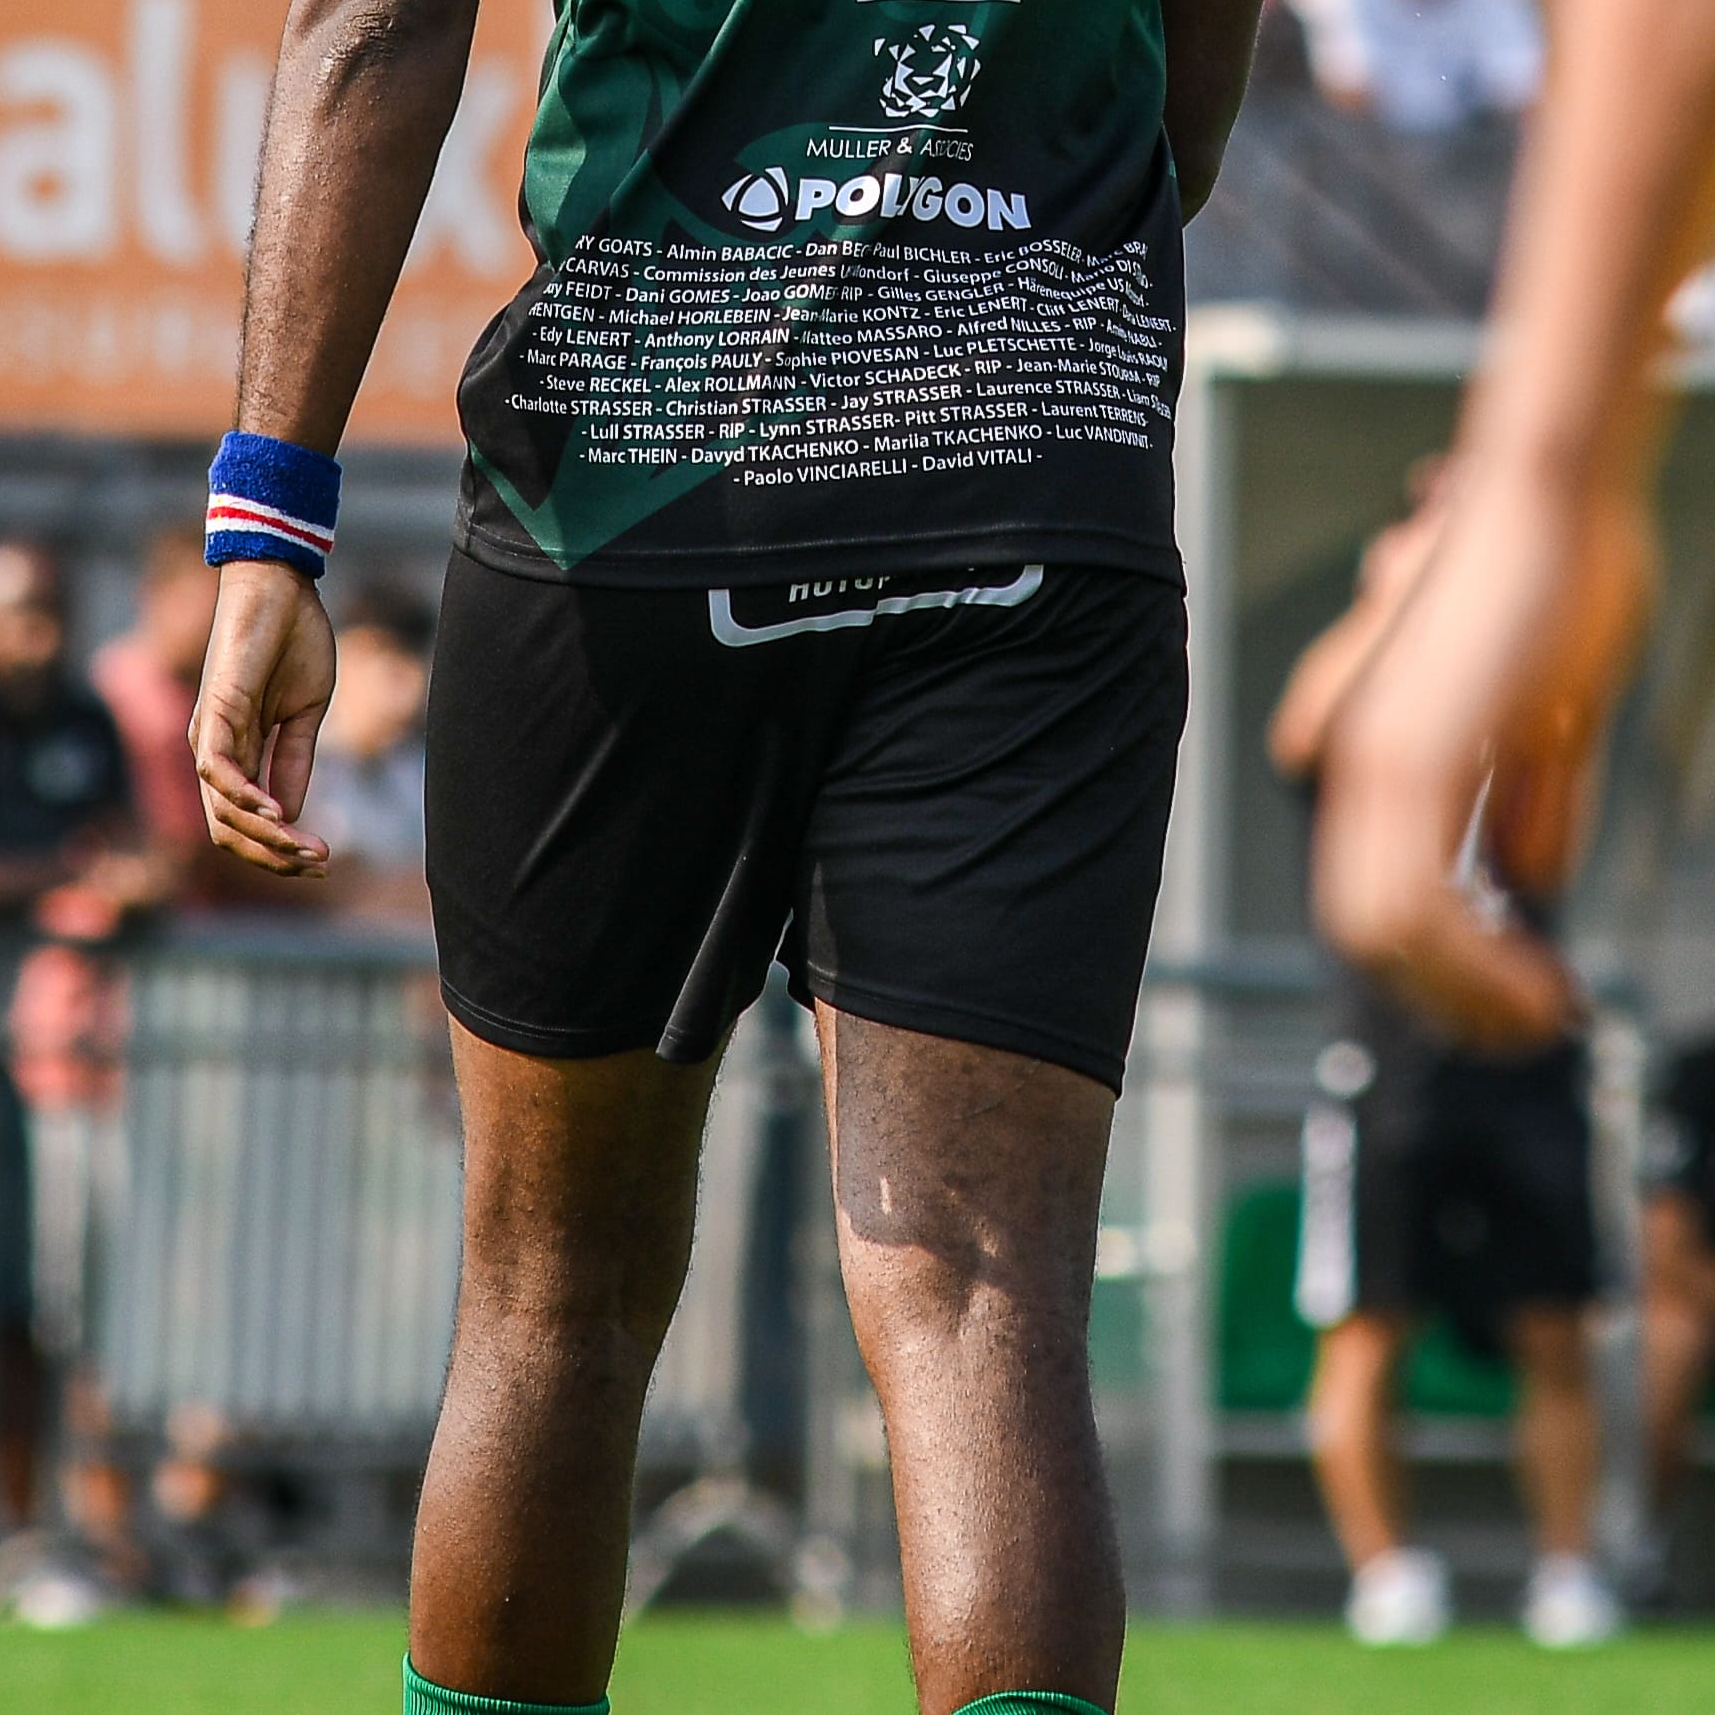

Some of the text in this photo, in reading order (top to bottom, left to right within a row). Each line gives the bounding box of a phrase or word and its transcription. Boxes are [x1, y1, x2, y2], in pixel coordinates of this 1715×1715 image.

[806, 138, 891, 158] MULLER
[897, 136, 913, 155] &
[795, 172, 1032, 231] POLYGON
[599, 238, 653, 256] GOATS
[667, 244, 716, 261] Almin
[721, 244, 794, 261] BABACIC
[806, 243, 838, 257] Dan
[842, 240, 870, 257] BEC
[873, 242, 900, 260] Paul
[904, 246, 971, 264] BICHLER
[984, 251, 1015, 264] Eric
[1019, 239, 1082, 263] BOSSELER
[644, 266, 745, 282] Commission
[750, 267, 777, 281] des
[780, 264, 836, 279] Jeunes
[924, 269, 1002, 285] Giuseppe
[566, 281, 612, 300] FEIDT
[626, 288, 665, 303] Dani
[669, 289, 730, 303] GOMES
[742, 288, 780, 302] Joao
[841, 287, 863, 301] RIP
[878, 287, 921, 302] Gilles
[925, 282, 1004, 302] GENGLER
[609, 309, 673, 324] Michael
[678, 308, 770, 324] HORLEBEIN
[863, 306, 920, 322] KONTZ
[934, 306, 965, 318] Eric
[968, 296, 1027, 317] LENERT
[1037, 303, 1066, 316] Cliff
[1068, 296, 1119, 313] LENERT
[541, 326, 562, 346] Edy
[567, 328, 631, 347] LENERT
[644, 332, 714, 349] Anthony
[718, 328, 789, 346] LORRAIN
[858, 325, 942, 343] MASSARO
[958, 316, 1007, 336] Alfred
[1011, 316, 1061, 333] NILLES
[1072, 317, 1097, 330] RIP
[527, 349, 556, 366] Marc
[560, 352, 627, 370] PARAGE
[641, 354, 707, 372] François
[711, 352, 762, 369] PAULY
[776, 352, 827, 370] Sophie
[831, 349, 919, 365] PIOVESAN
[934, 344, 964, 358] Luc
[967, 336, 1077, 355] PLETSCHETTE
[1088, 338, 1116, 358] Jorge
[546, 375, 585, 391] Steve
[590, 377, 651, 392] RECKEL
[665, 377, 700, 392] Alex
[705, 375, 796, 392] ROLLMANN
[809, 373, 860, 388] Victor
[865, 363, 961, 385] SCHADECK
[974, 360, 1002, 374] RIP
[1016, 358, 1097, 374] Jean-Marie
[511, 380, 1150, 416] Charlotte STRASSER Christian STRASSER Jay STRASSER Laurence STRASSER Liam
[591, 423, 619, 439] Lull
[623, 424, 705, 439] STRASSER
[719, 423, 745, 439] RIP
[760, 422, 801, 440] Lynn
[905, 410, 936, 426] Pitt
[940, 403, 1028, 421] STRASSER
[1041, 401, 1098, 417] Laurent
[588, 448, 627, 463] Marc
[628, 448, 677, 463] THEIN
[692, 446, 744, 466] Davyd
[748, 439, 859, 462] TKACHENKO
[932, 424, 1042, 446] TKACHENKO
[1055, 424, 1083, 439] Luc
[744, 448, 1032, 486] Paolo VINCIARELLI David VITALI
